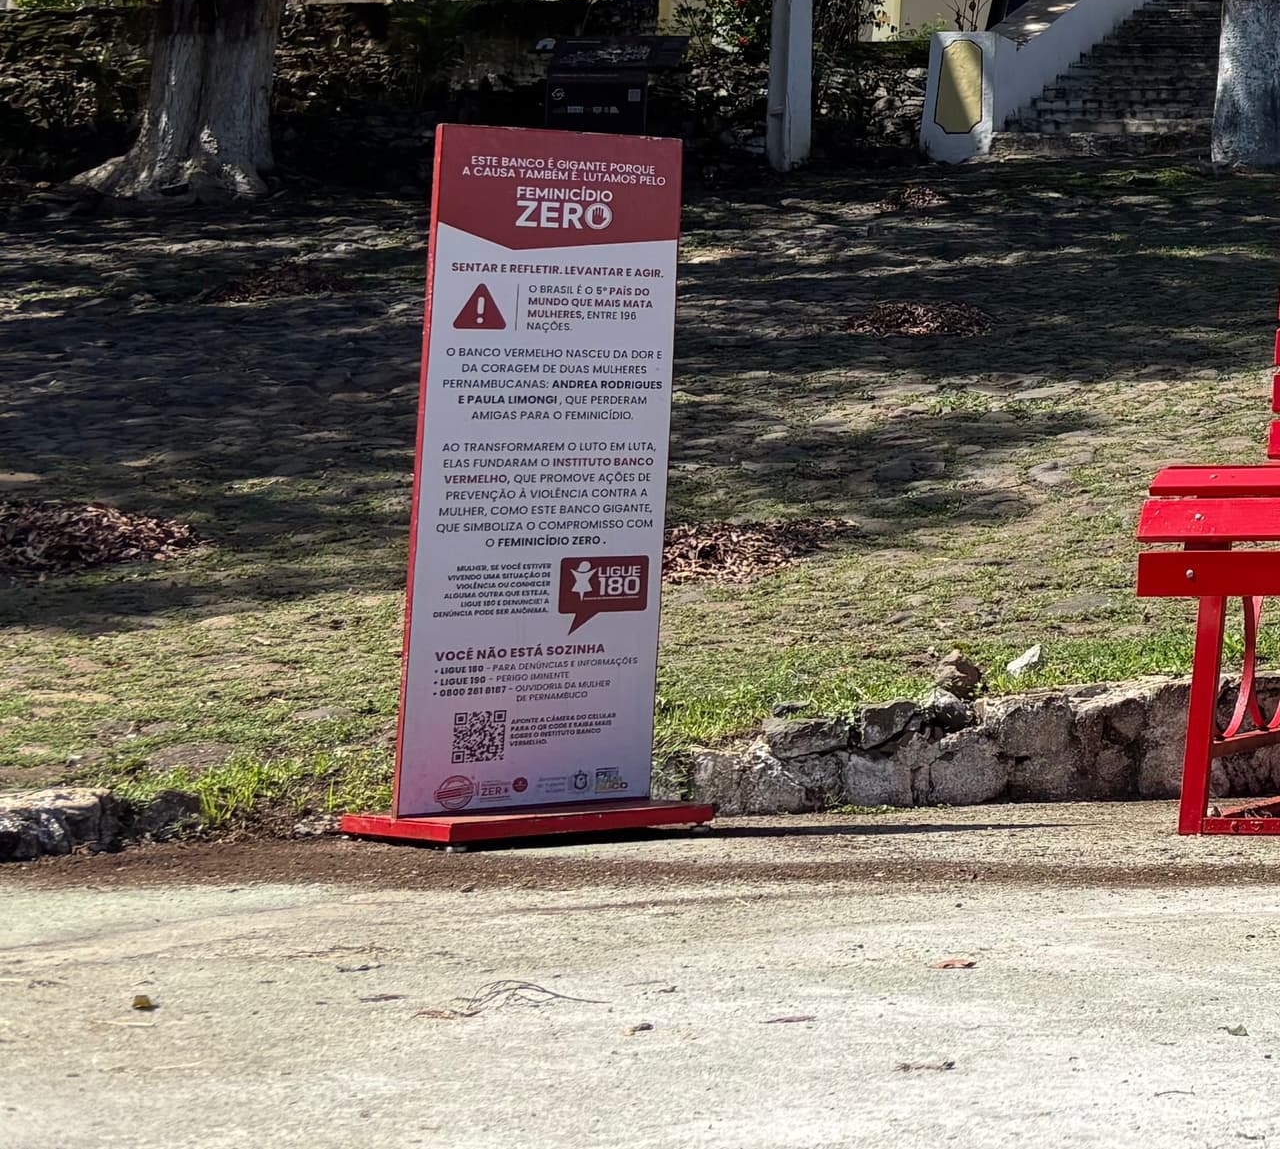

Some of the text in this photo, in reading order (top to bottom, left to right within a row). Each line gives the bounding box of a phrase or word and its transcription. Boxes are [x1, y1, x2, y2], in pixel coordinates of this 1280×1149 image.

[471, 156, 654, 176] ESTE BANCO É GIGANTE PORQUE
[461, 167, 665, 186] A CAUSA TAMBÉM É. LUTAMOS PELO
[516, 184, 612, 202] FEMINICÍDIO
[515, 202, 612, 229] ZERO
[451, 262, 663, 278] SENTAR E REFLETIR. LEVANTAR E AGIR.
[528, 285, 537, 294] O
[539, 285, 573, 294] BRASIL
[576, 284, 582, 295] É
[584, 286, 593, 295] O
[609, 285, 632, 296] PAÍS
[634, 288, 649, 296] DO
[527, 298, 652, 309] MUNDO QUE MAIS MATA
[527, 310, 636, 320] MULHERES, ENTRE 196
[526, 320, 572, 332] NAÇÕES.
[446, 348, 662, 359] O BANCO VERMELHO NASCEU DA DOR E
[461, 364, 646, 374] DA CORAGEM DE DUAS MULHERES
[442, 380, 662, 389] PERNAMBUCANAS: ANDREA RODRIGUES
[457, 396, 464, 404] E
[466, 396, 505, 404] PAULA
[564, 396, 587, 406] QUE
[590, 396, 647, 404] PERDERAM
[471, 409, 633, 420] AMIGAS PARA O FEMINICÍDIO.
[441, 443, 656, 452] AO TRANSFORMAREM O LUTO EM LUTA,
[442, 458, 654, 468] ELAS FUNDARAM O INSTITUTO BANCO
[444, 471, 650, 485] VERMELHO, QUE PROMOVE AÇÕES DE
[445, 487, 648, 501] PREVENÇÃO À VIOLÊNCIA CONTRA A
[438, 504, 652, 517] MULHER, COMO ESTE BANCO GIGANTE,
[435, 520, 652, 533] QUE SIMBOLIZA O COMPROMISSO COM
[485, 538, 494, 547] O
[497, 535, 569, 547] FEMINICÍDIO
[598, 566, 641, 577] LIGUE
[598, 576, 640, 595] 180
[434, 644, 604, 661] VOCÊ NÃO ESTÁ SOZINHA
